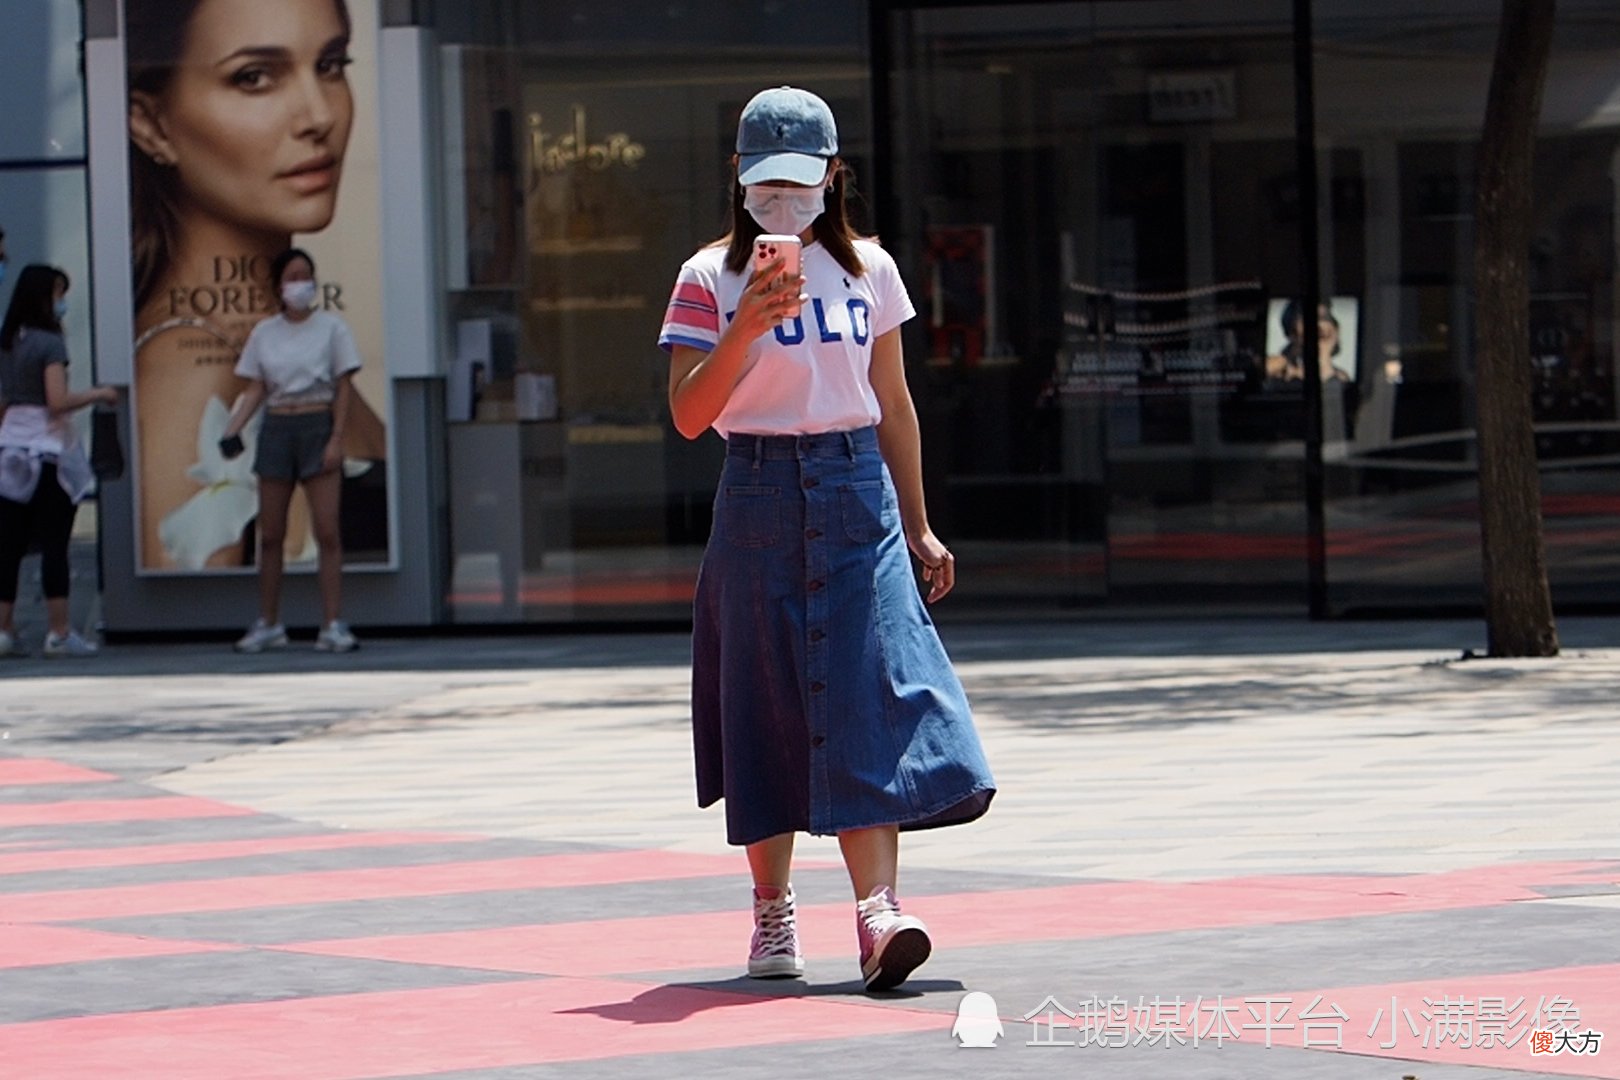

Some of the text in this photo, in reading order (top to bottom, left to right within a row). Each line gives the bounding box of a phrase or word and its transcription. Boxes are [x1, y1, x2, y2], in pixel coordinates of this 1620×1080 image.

[214, 254, 273, 283] DIO
[169, 282, 345, 316] FORER
[725, 298, 869, 346] OLO
